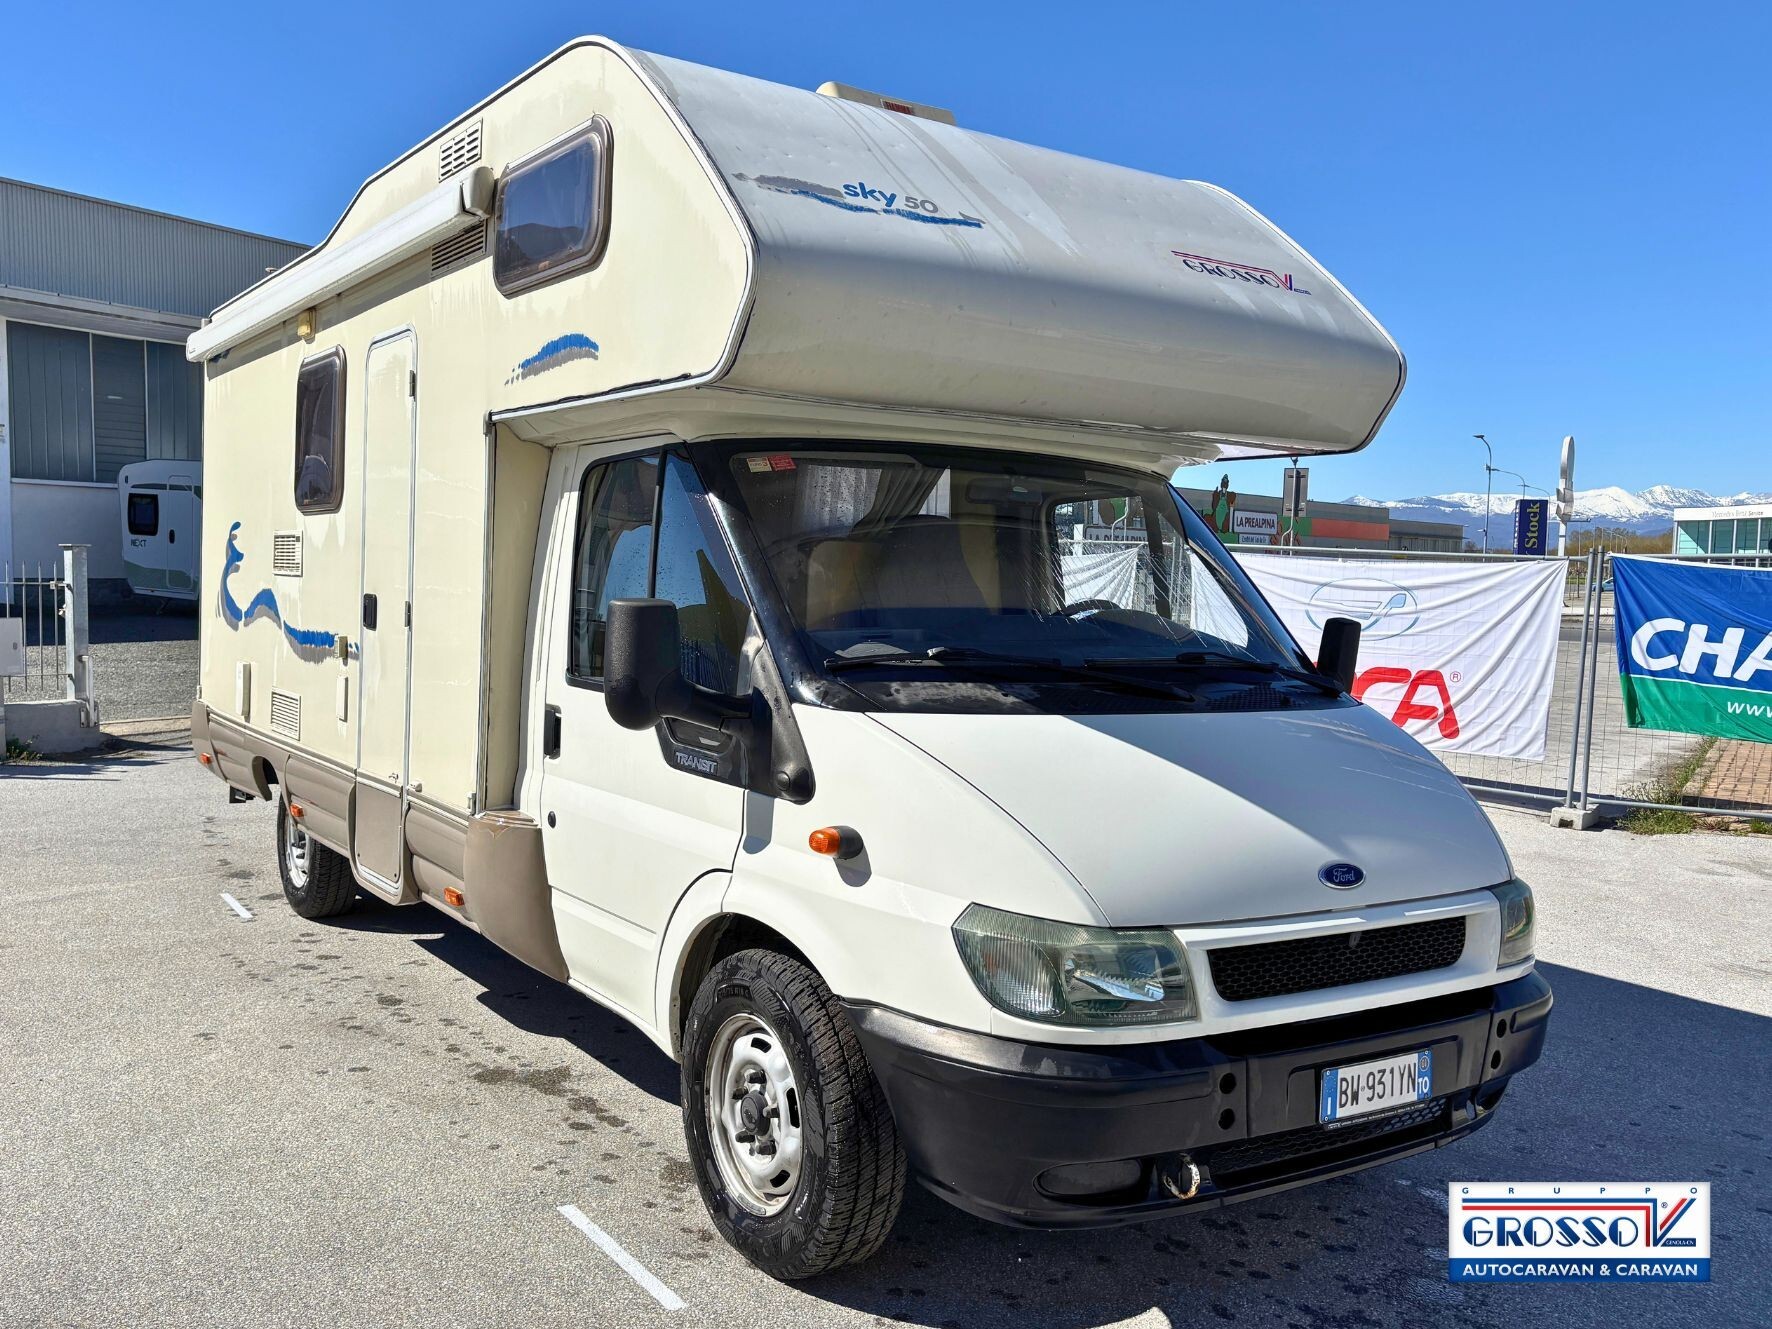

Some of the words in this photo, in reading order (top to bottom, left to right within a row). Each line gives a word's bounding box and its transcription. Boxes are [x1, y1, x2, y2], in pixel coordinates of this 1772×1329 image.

[843, 181, 897, 208] sky
[904, 195, 939, 214] 50
[1182, 258, 1280, 289] GROSSO
[1236, 516, 1244, 528] LA
[1244, 517, 1276, 530] PREALPINA
[1525, 502, 1540, 549] Stock
[130, 538, 147, 548] NEXT
[1727, 701, 1772, 719] ww
[675, 751, 718, 773] TRANSIT
[1332, 867, 1356, 883] Ford
[1338, 1074, 1361, 1109] BW
[1366, 1062, 1417, 1102] 931YN
[1417, 1076, 1430, 1095] TO
